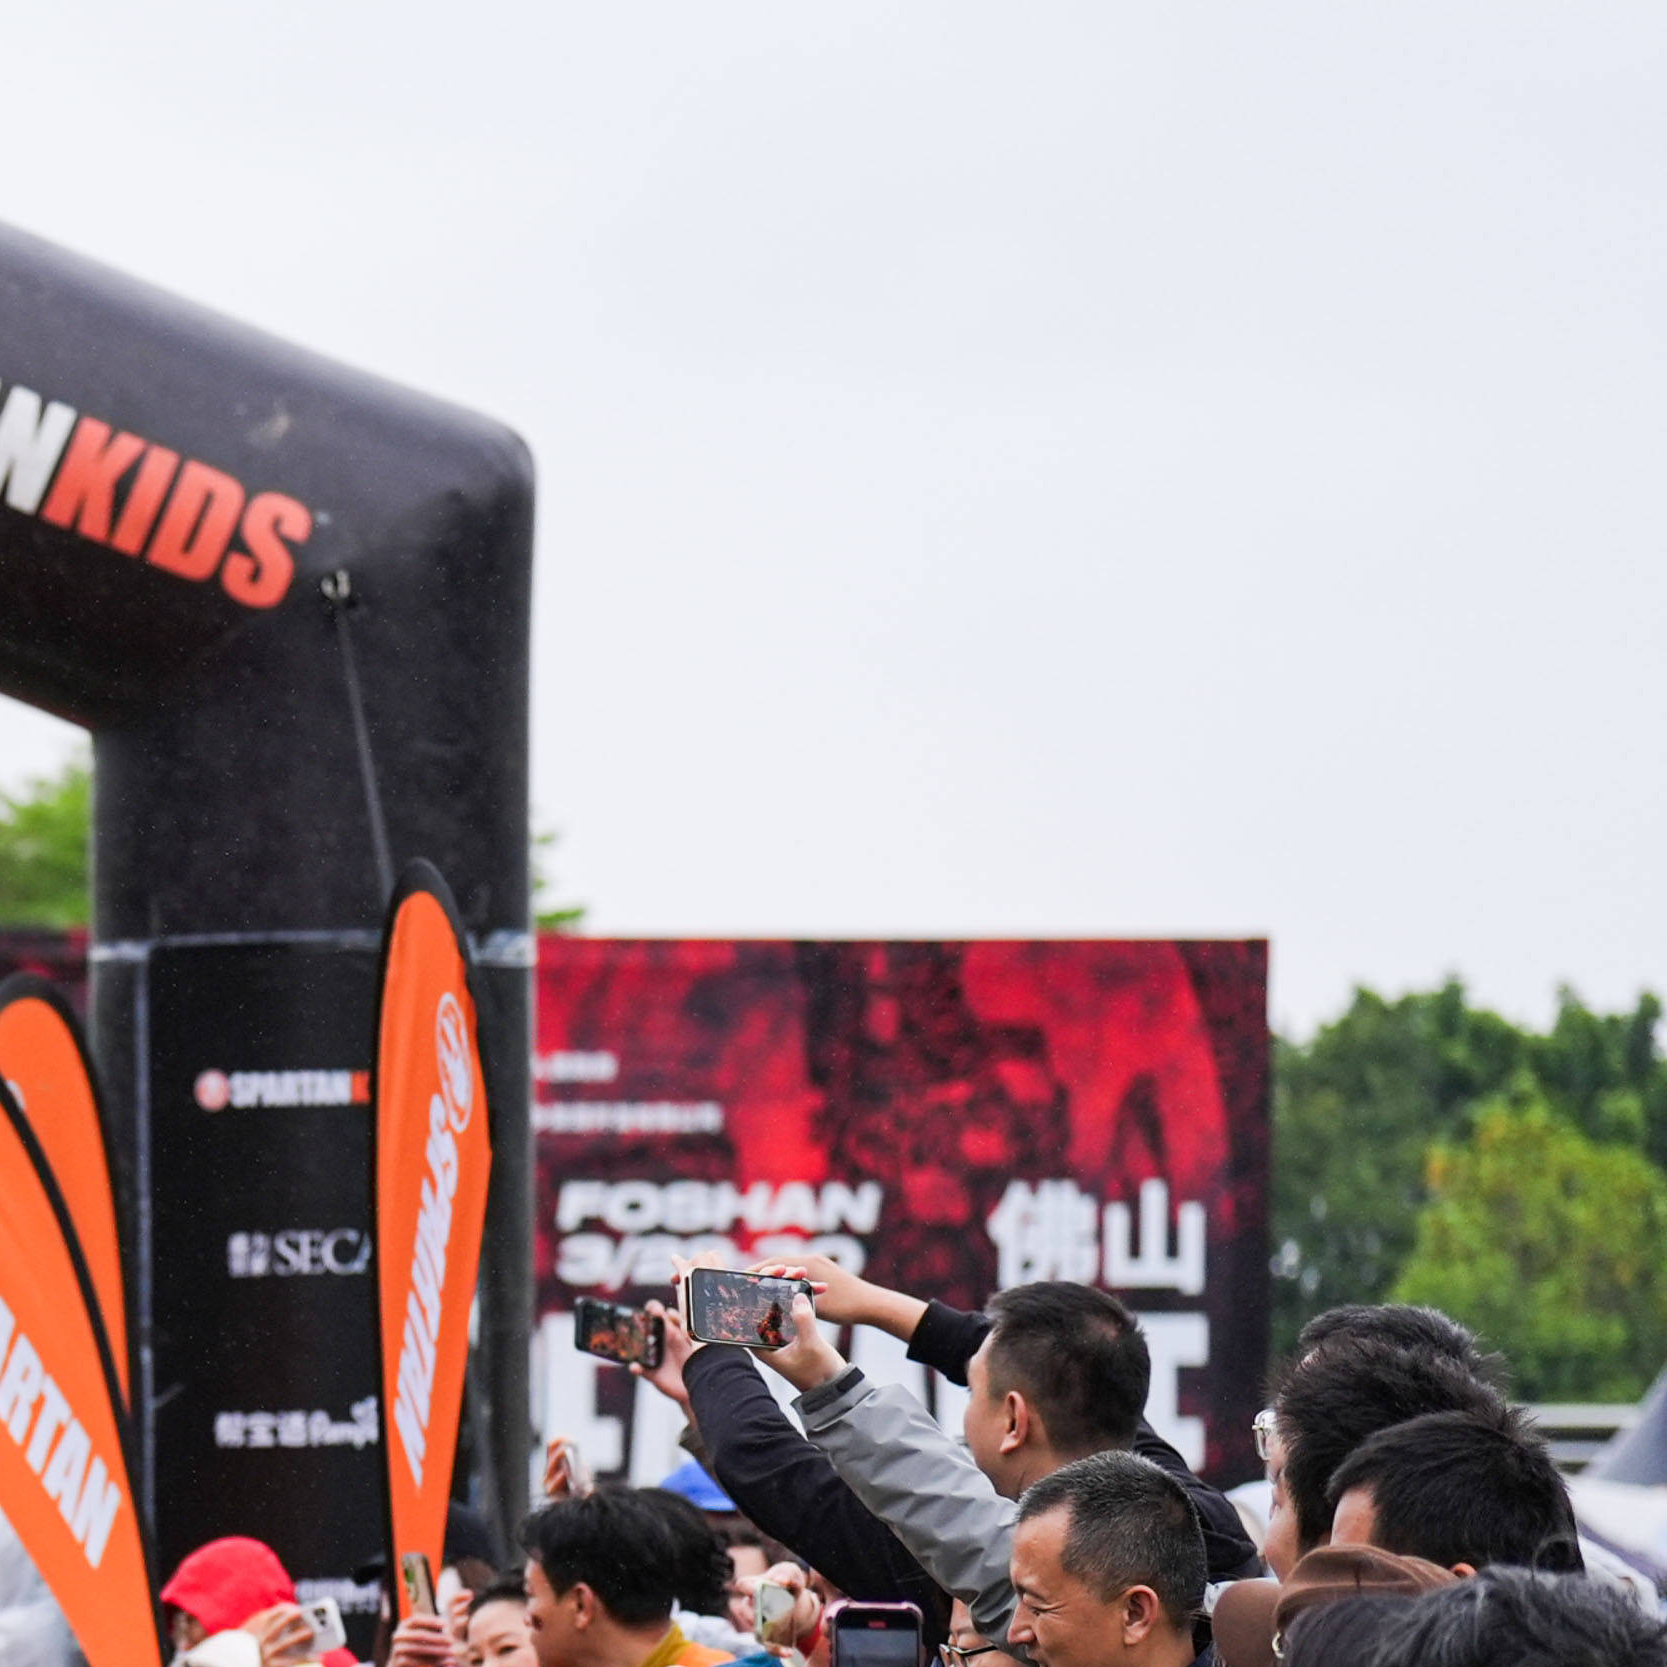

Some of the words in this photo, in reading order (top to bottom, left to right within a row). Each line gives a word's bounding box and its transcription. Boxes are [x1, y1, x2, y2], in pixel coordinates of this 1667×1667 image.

[555, 1179, 883, 1235] FOSHAN
[988, 1178, 1208, 1295] 佛山
[394, 1094, 459, 1489] SPARTAN
